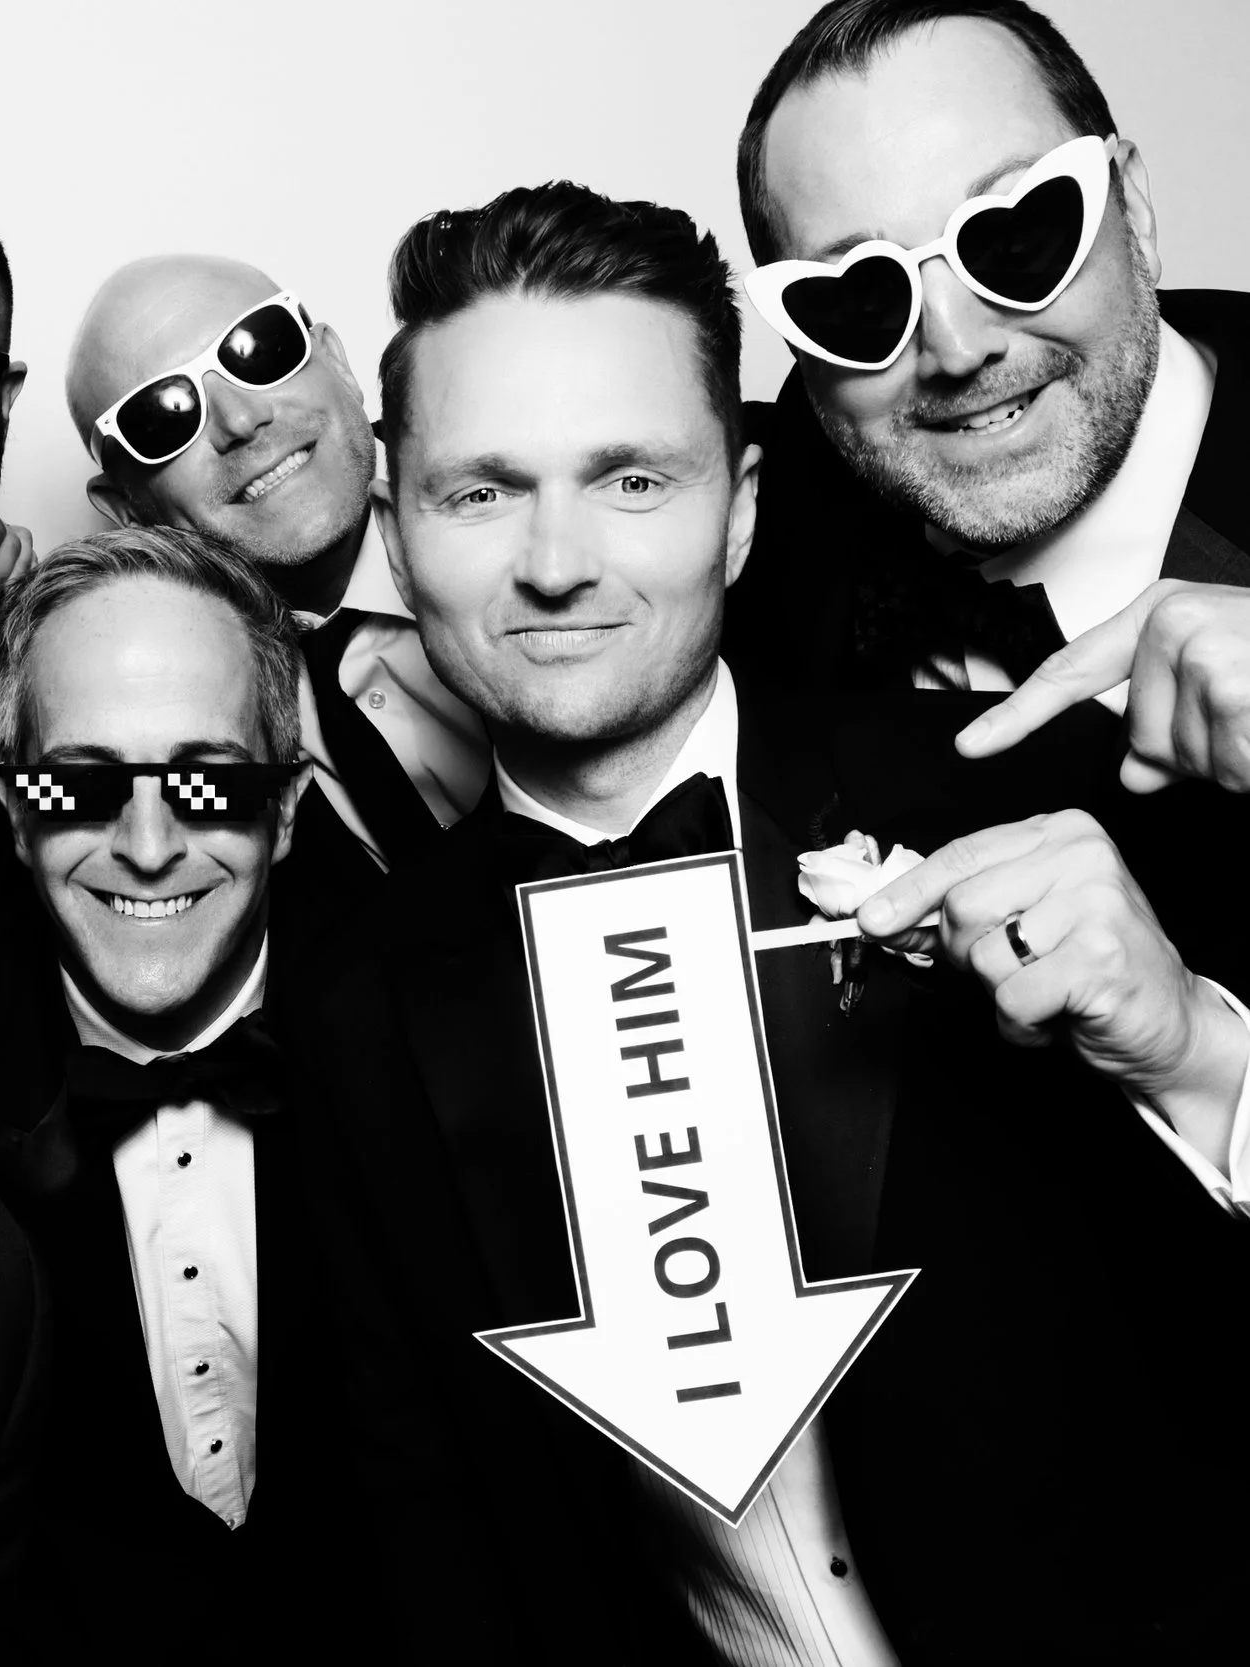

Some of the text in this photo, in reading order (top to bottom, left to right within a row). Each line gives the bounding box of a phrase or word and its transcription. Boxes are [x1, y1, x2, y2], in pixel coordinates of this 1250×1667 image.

[603, 926, 742, 1403] I LOVE HIM
